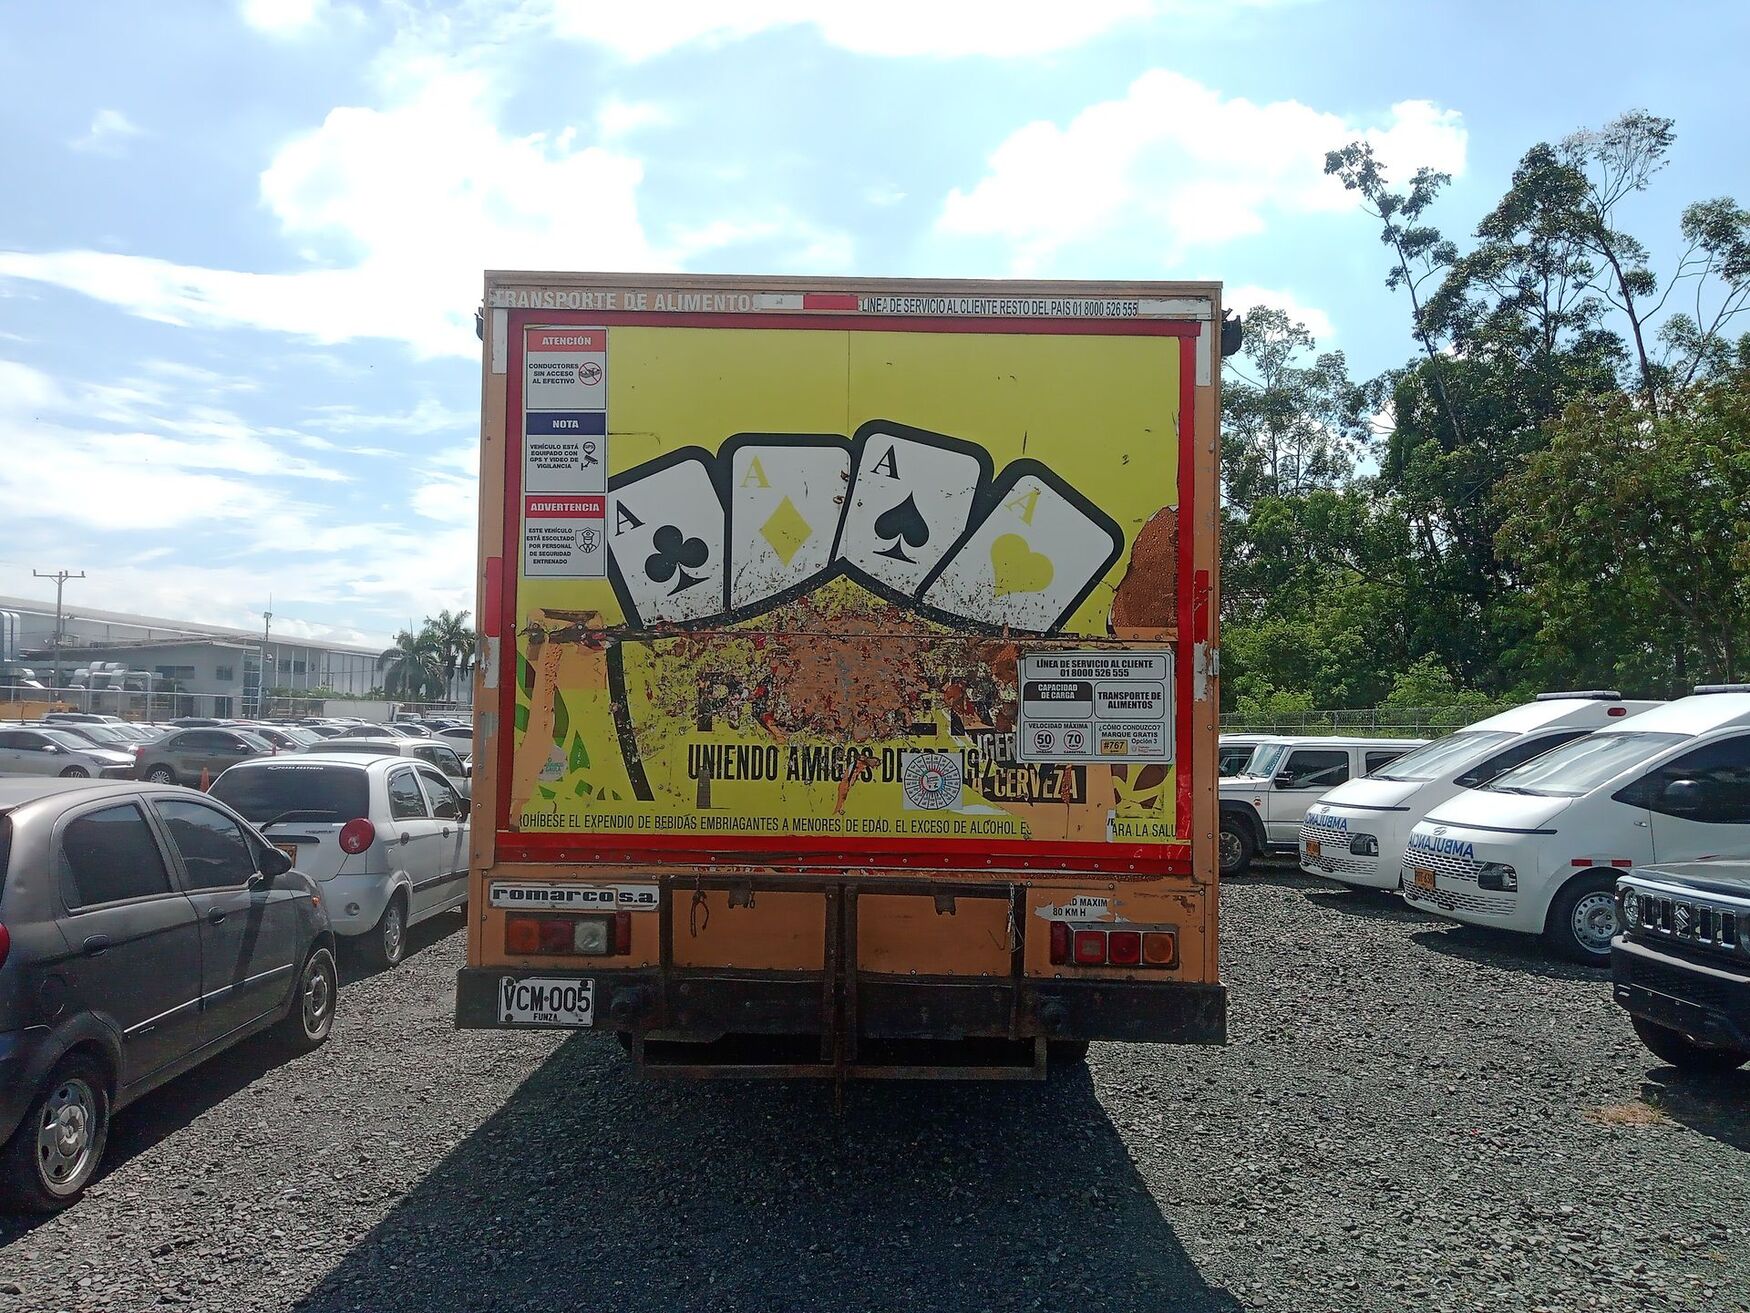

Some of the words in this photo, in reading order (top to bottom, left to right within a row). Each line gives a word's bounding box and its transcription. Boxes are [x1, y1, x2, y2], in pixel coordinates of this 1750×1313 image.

[497, 289, 616, 310] TRANSPORTE
[624, 292, 647, 311] DE
[890, 299, 902, 312] DE
[904, 299, 945, 313] SERVICIO
[947, 299, 958, 313] AL
[960, 300, 997, 314] CLIENTE
[1000, 300, 1030, 315] RESTO
[1032, 301, 1049, 315] DEL
[1073, 301, 1082, 316] 01
[1085, 301, 1104, 316] 8000
[1106, 302, 1121, 316] 526
[1123, 302, 1138, 317] 555
[542, 336, 592, 345] ATENCIÓN
[552, 420, 579, 429] NOTA
[870, 445, 901, 481] A
[739, 455, 773, 489] A
[530, 503, 600, 512] ADVERTENCIA
[1004, 489, 1042, 528] A
[614, 499, 646, 537] A
[1036, 658, 1059, 669] LÍNEA
[1060, 660, 1071, 669] DE
[1072, 660, 1110, 669] SERVICIO
[1111, 660, 1121, 669] AL
[1122, 660, 1153, 669] CLIENTE
[1060, 669, 1070, 678] 01
[1072, 669, 1094, 678] 8000
[1095, 669, 1111, 678] 526
[1113, 669, 1129, 678] 555
[1038, 684, 1078, 692] CAPACIDAD
[1098, 692, 1149, 700] TRANSPORTE
[1150, 692, 1162, 700] DE
[1108, 701, 1153, 709] ALIMENTOS
[1037, 734, 1052, 745] 50
[1067, 734, 1081, 745] 70
[688, 744, 778, 782] UNIENDO
[786, 745, 873, 782] AMIGOS
[569, 814, 580, 828] EL
[585, 814, 634, 829] EXPENDIO
[638, 815, 651, 829] DE
[655, 816, 697, 830] BEBIDAS
[701, 816, 778, 831] EMBRIAGANTES
[782, 818, 789, 831] A
[793, 818, 841, 832] MENORES
[846, 819, 858, 832] DE
[862, 820, 891, 833] EDAD.
[896, 820, 907, 833] EL
[912, 820, 949, 834] EXCESO
[954, 820, 966, 834] DE
[970, 820, 1016, 835] ALCOHOL
[1136, 823, 1149, 837] LA
[493, 889, 614, 902] romarco
[618, 892, 658, 904] s.a.
[1052, 907, 1063, 916] 80
[1065, 908, 1079, 917] KM
[1080, 908, 1086, 917] H
